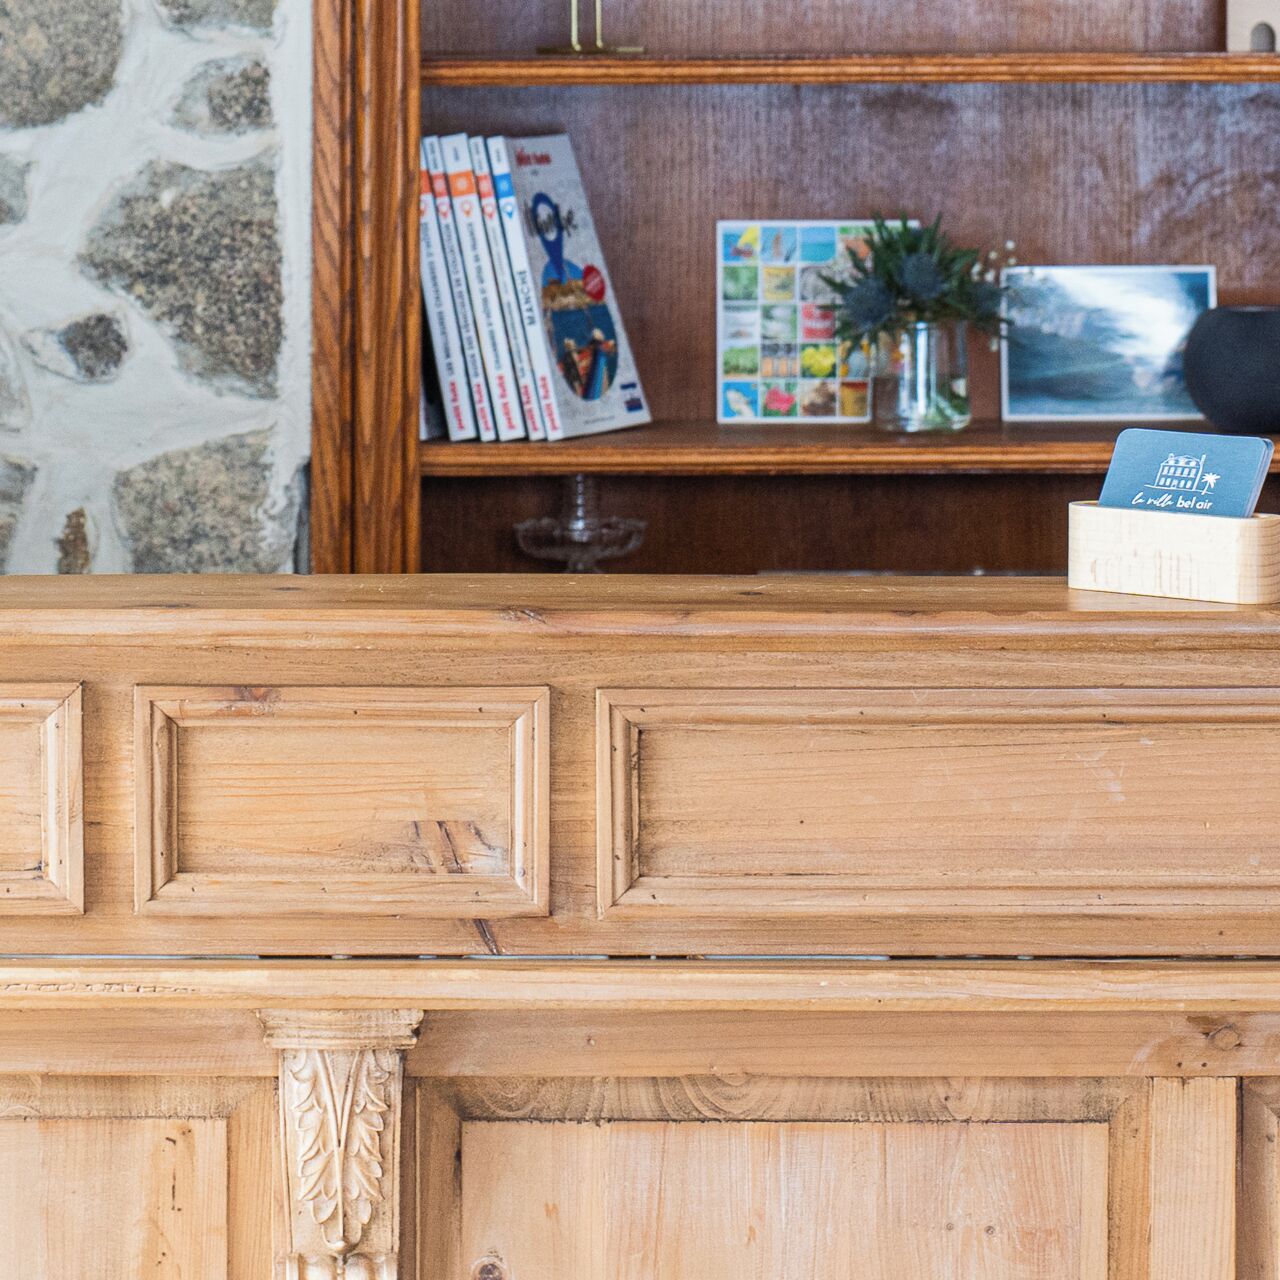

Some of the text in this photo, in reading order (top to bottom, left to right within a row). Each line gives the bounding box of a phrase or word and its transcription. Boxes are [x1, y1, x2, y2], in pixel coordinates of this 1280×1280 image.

[517, 270, 536, 326] MANCHE
[450, 381, 459, 403] futé
[497, 375, 508, 399] futé
[540, 376, 550, 400] futé
[453, 405, 464, 431] petit
[502, 402, 516, 430] petit
[545, 403, 558, 431] petit
[1176, 495, 1195, 510] bel
[1197, 498, 1214, 510] air
